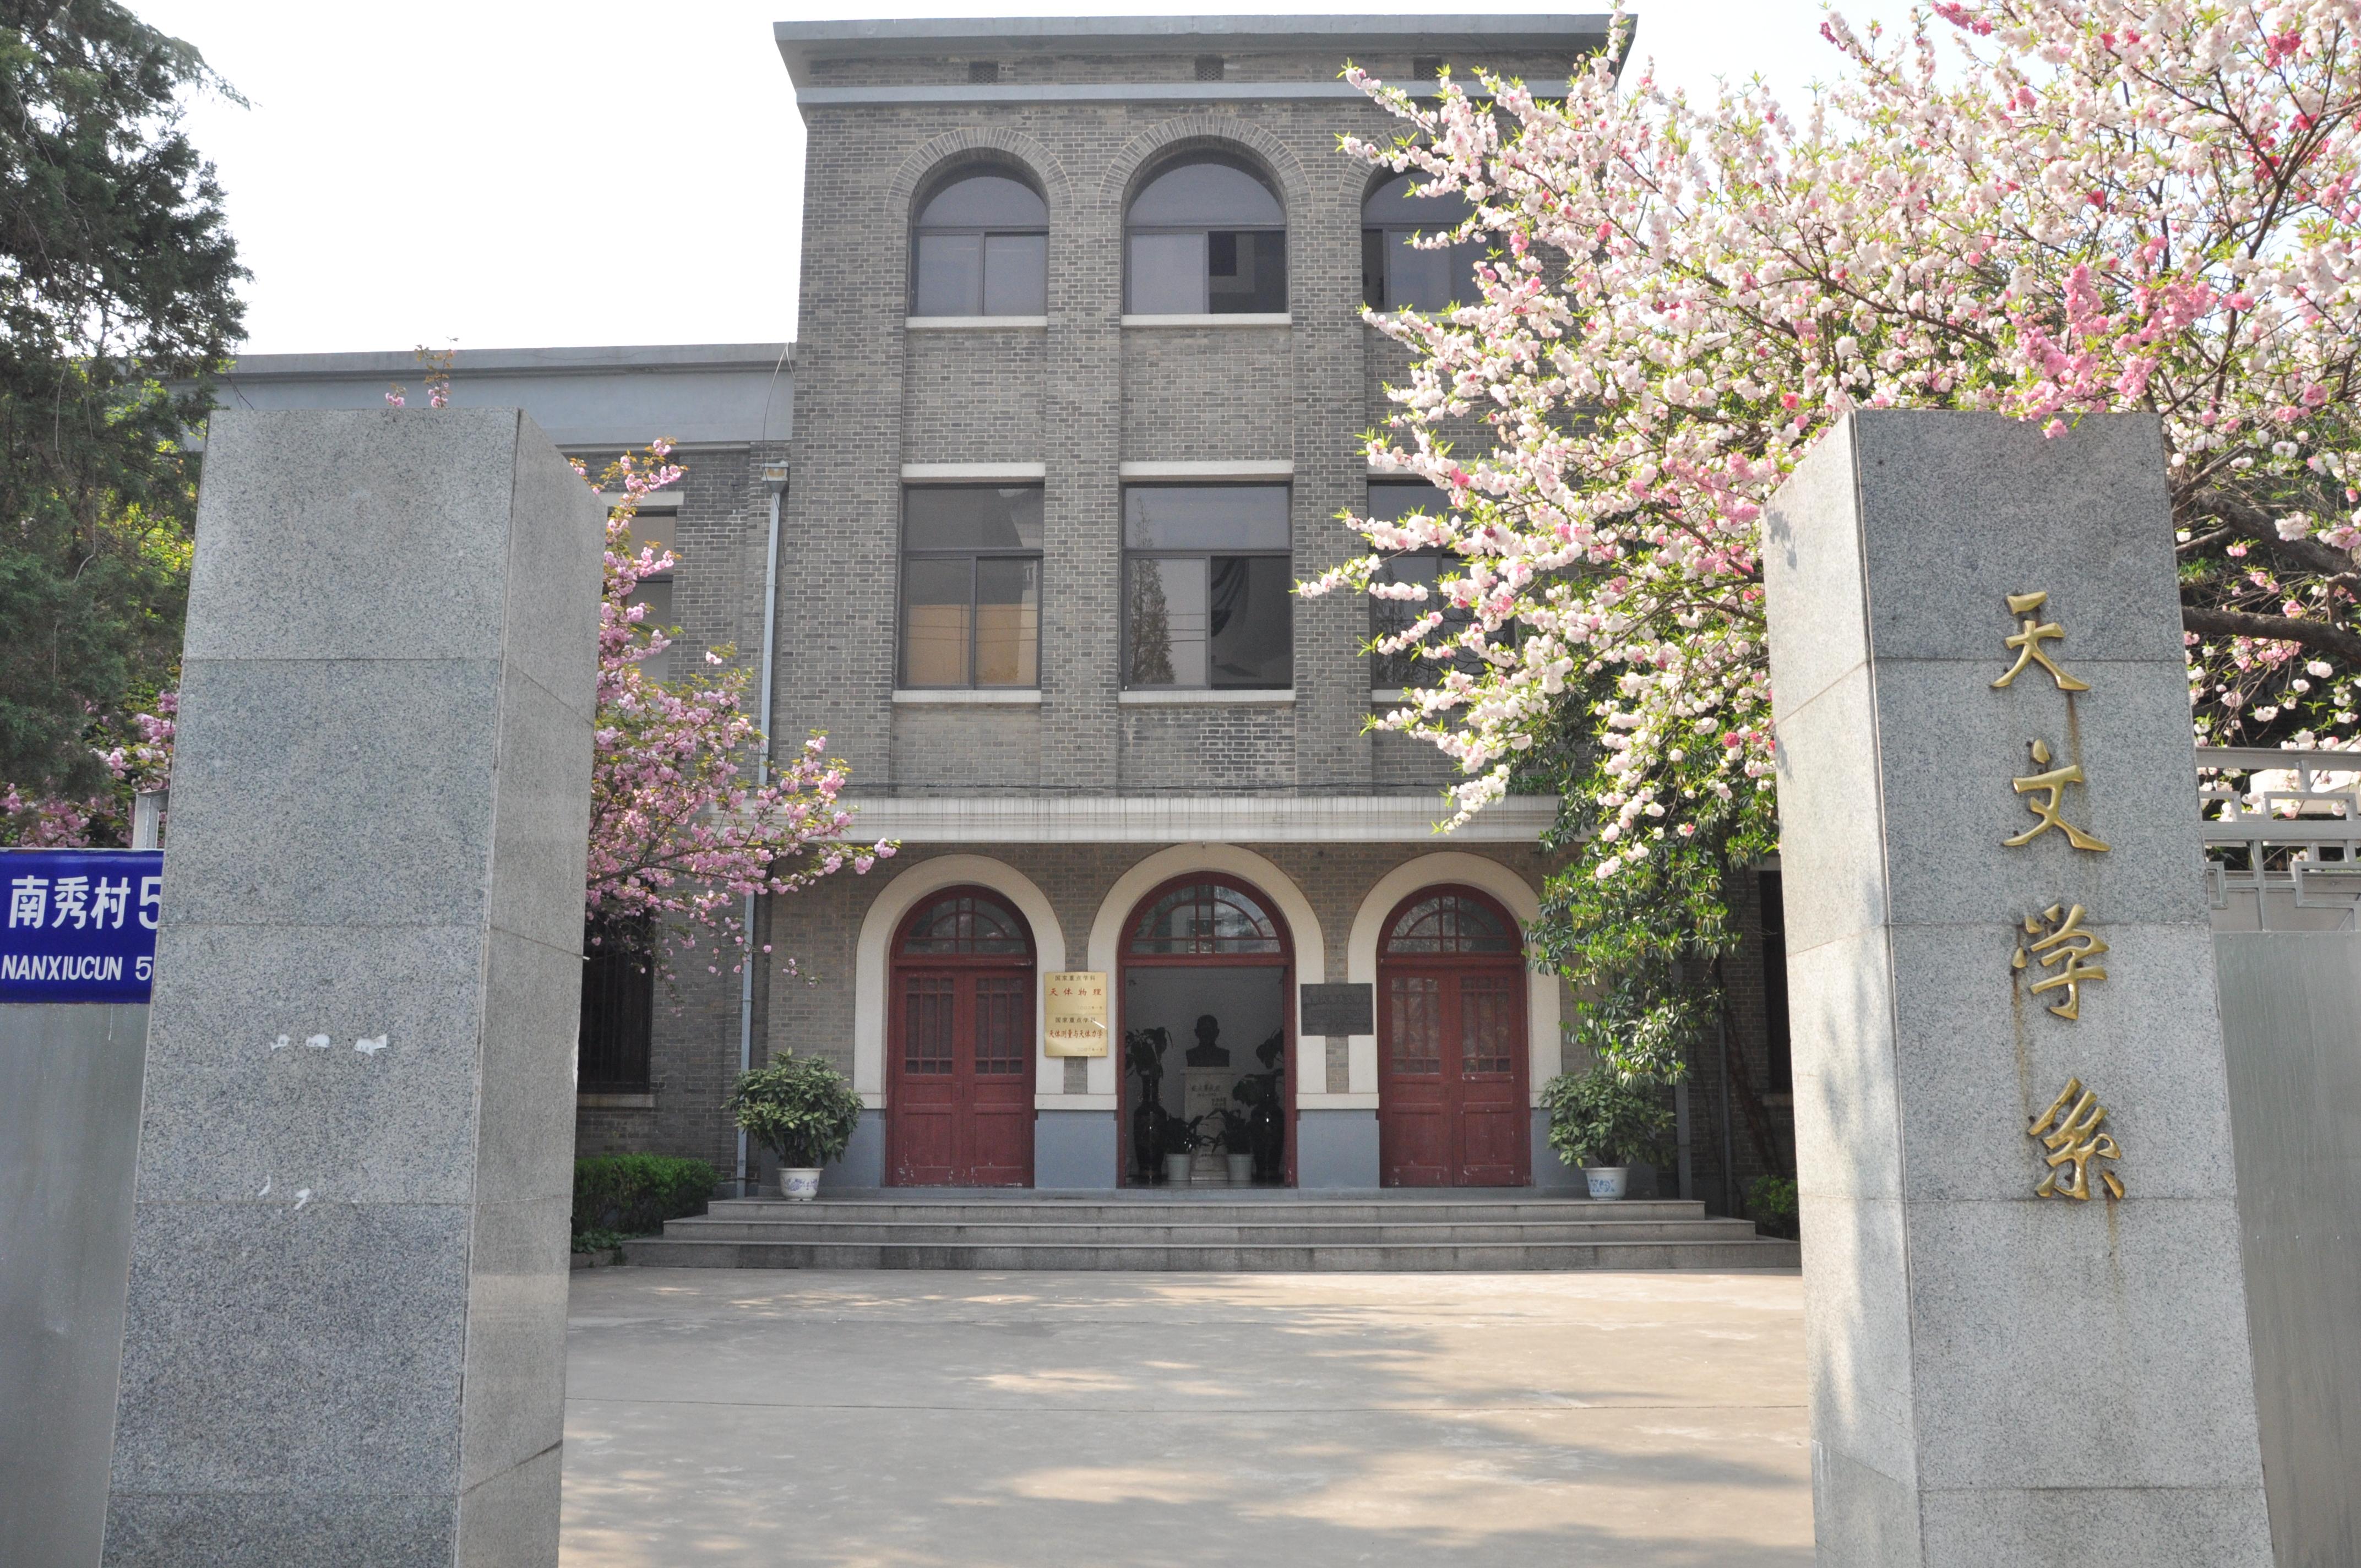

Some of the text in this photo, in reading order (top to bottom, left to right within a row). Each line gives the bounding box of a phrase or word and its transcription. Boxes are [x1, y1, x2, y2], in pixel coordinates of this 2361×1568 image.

[1, 955, 153, 981] NANXIUCUN 5
[1049, 987, 1102, 996] 天体物理
